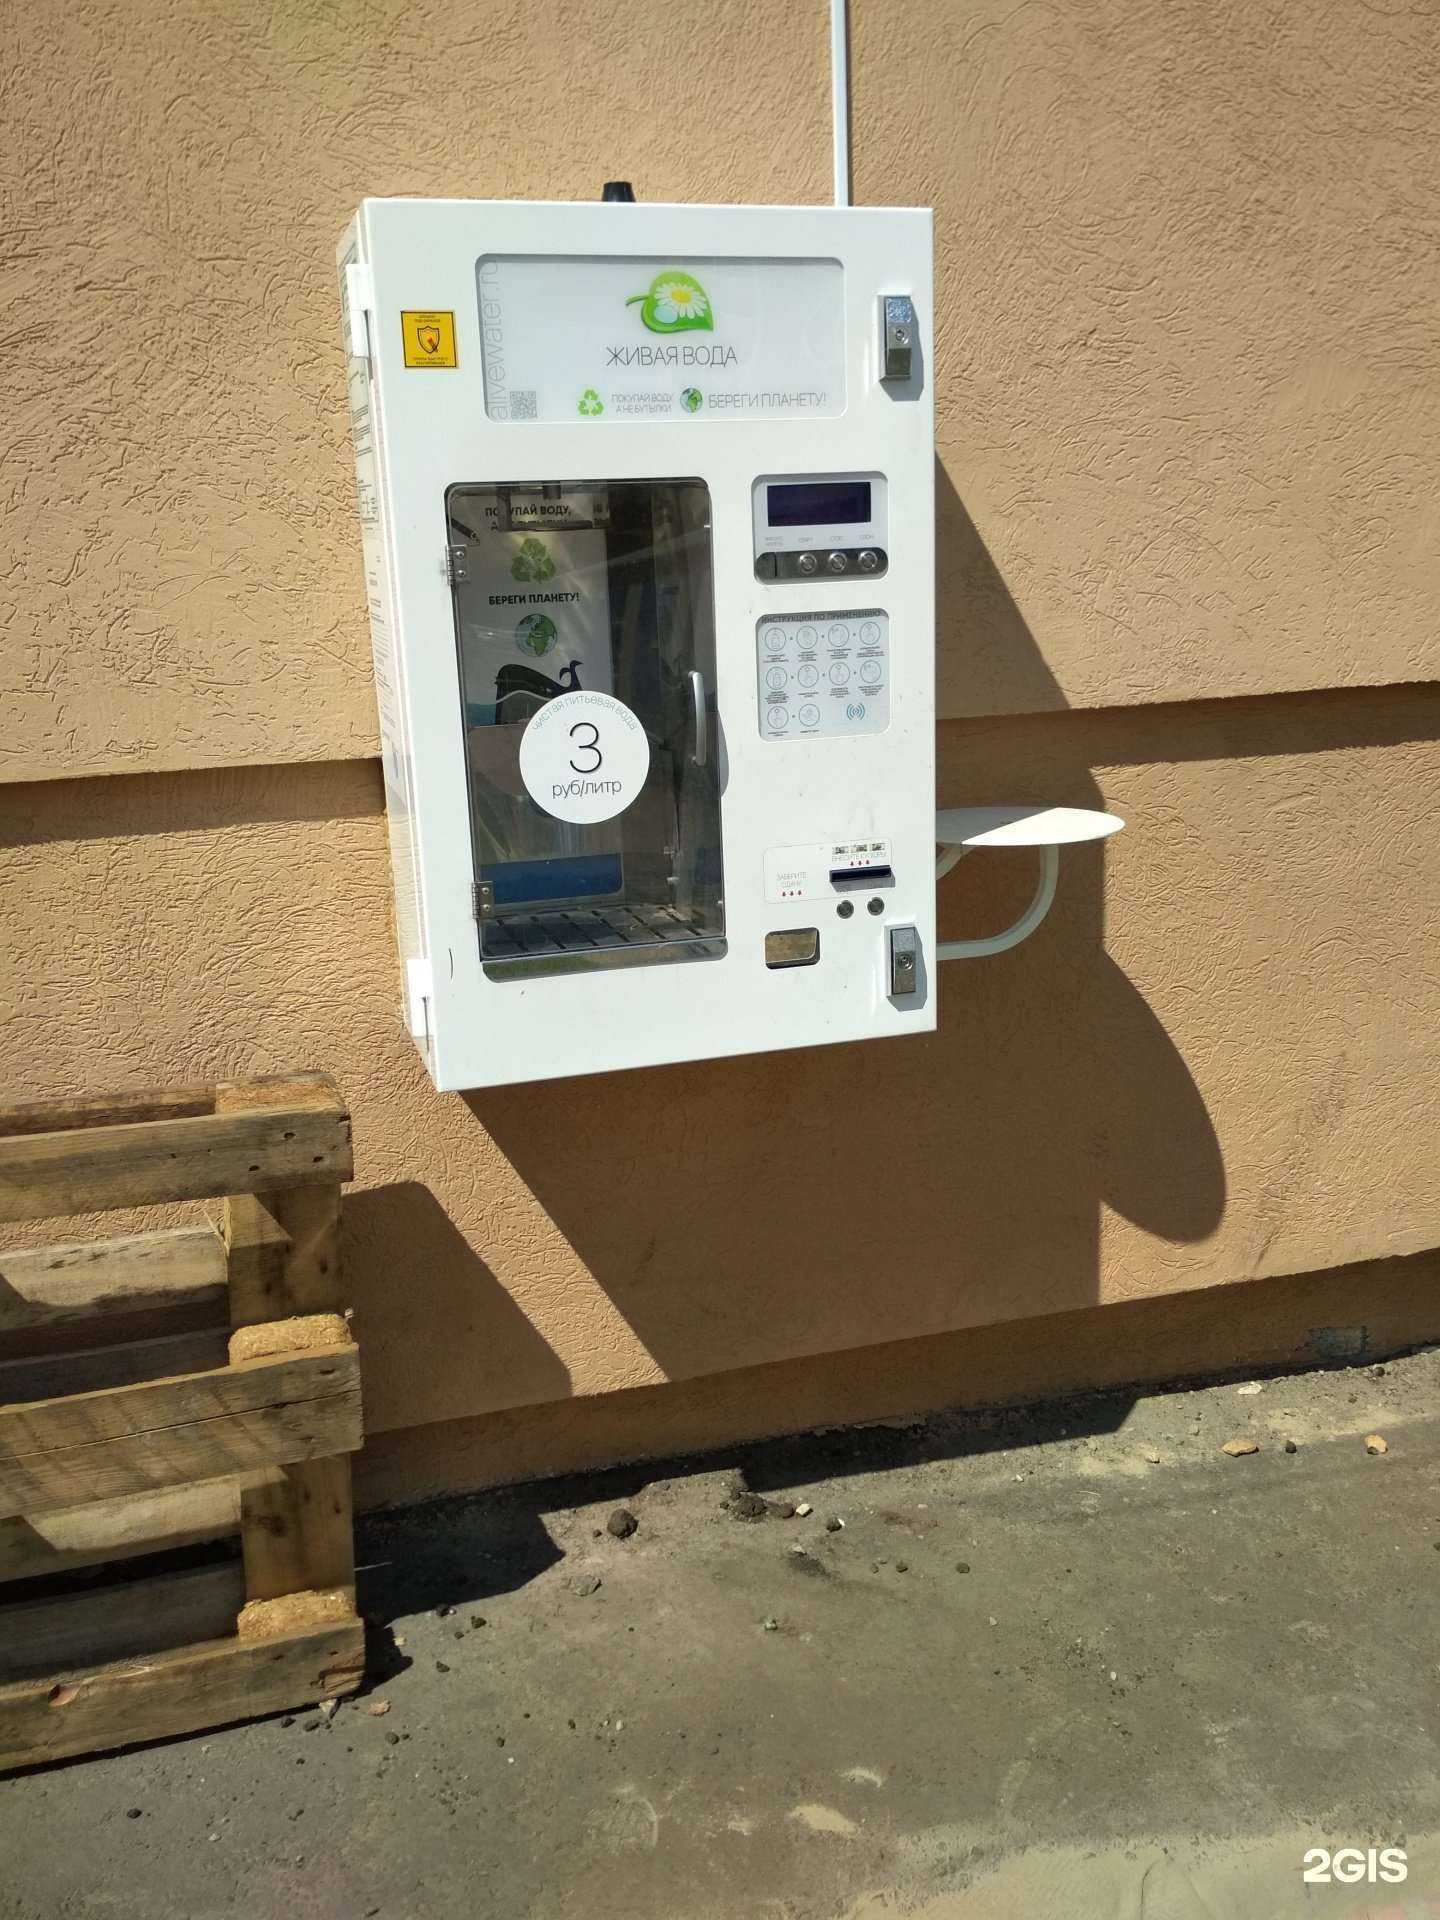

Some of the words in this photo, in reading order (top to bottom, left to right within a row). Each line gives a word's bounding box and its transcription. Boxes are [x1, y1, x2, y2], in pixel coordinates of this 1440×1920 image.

[606, 346, 679, 367] ЖИВАЯ
[683, 346, 738, 368] ВОДА
[709, 394, 760, 409] БЕРЕГИ
[762, 391, 826, 407] ПЛАНЕТУ!
[485, 504, 537, 517] ПОУПАЙ
[540, 505, 571, 515] ВОДУ,
[488, 595, 526, 606] БЕРЕГИ
[528, 592, 580, 603] ПЛАНЕТУ!
[569, 722, 603, 774] 3
[552, 779, 622, 799] руб/литр
